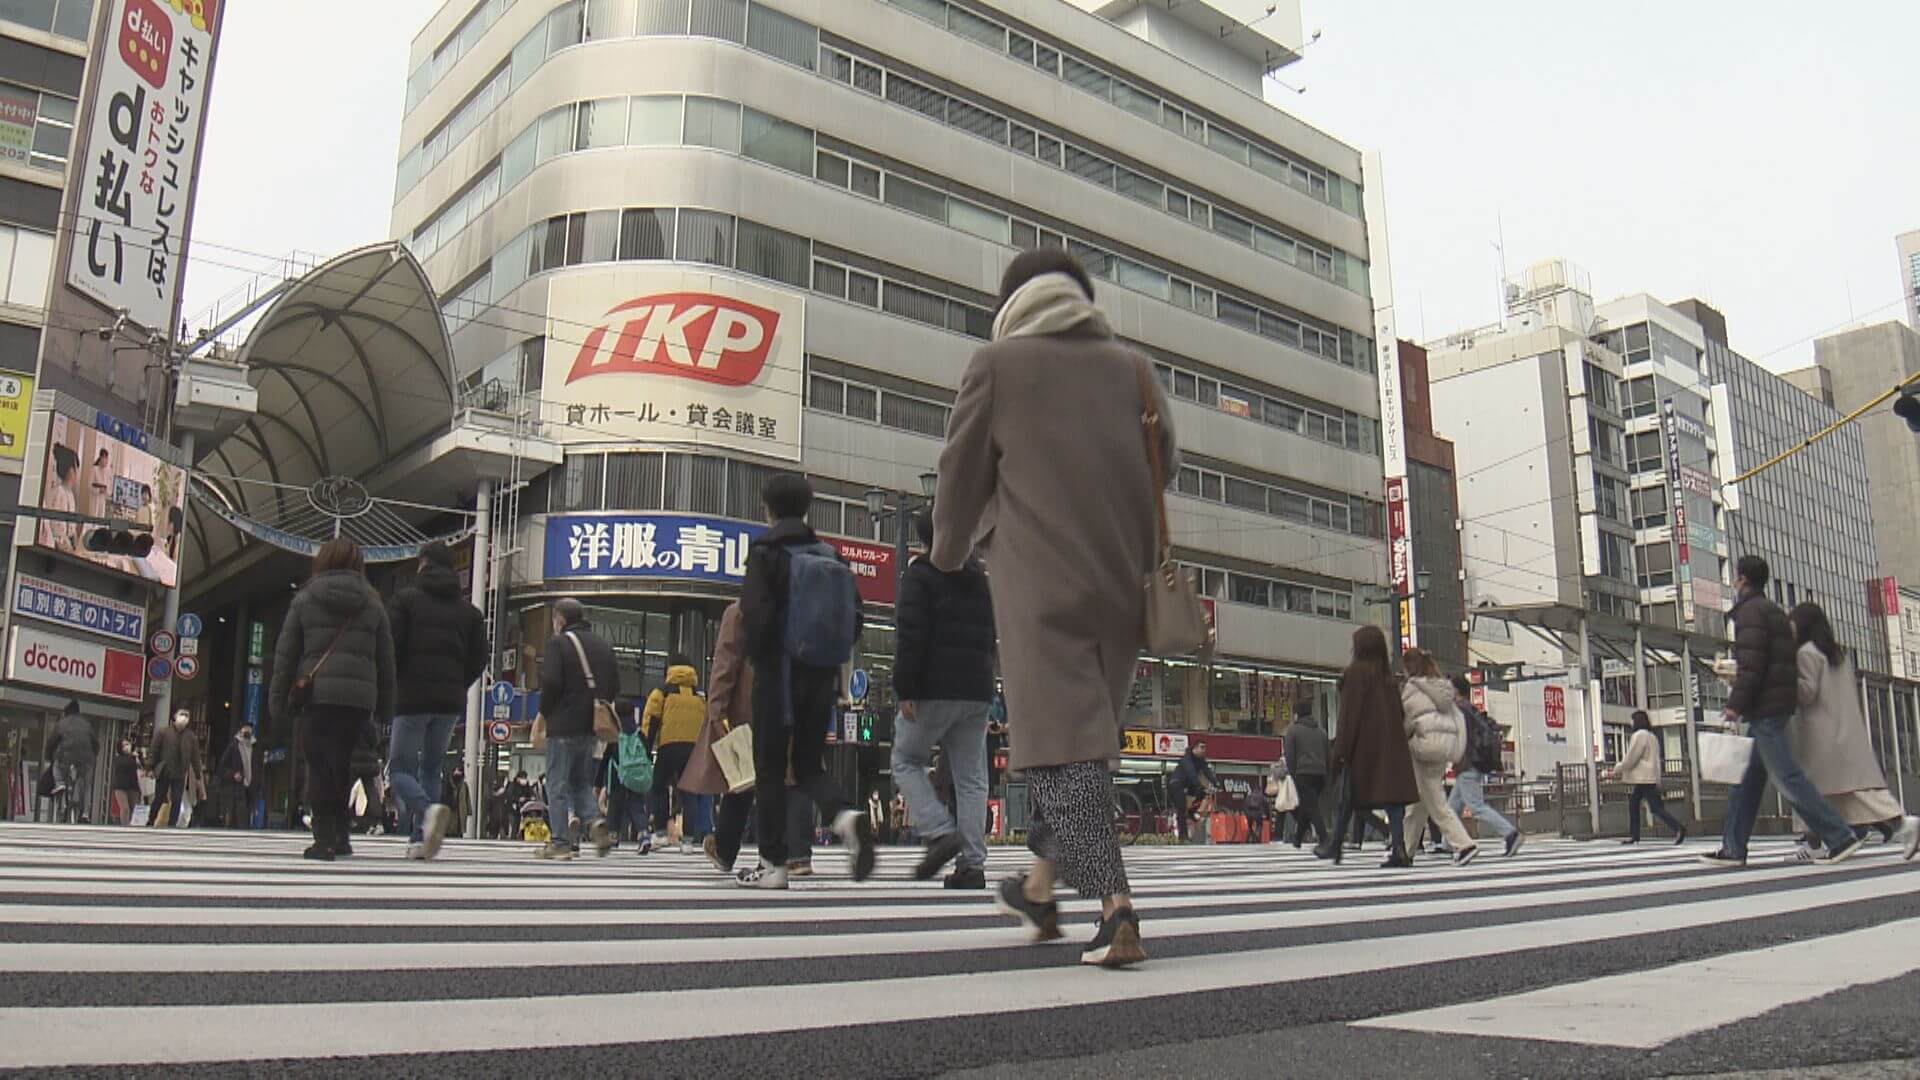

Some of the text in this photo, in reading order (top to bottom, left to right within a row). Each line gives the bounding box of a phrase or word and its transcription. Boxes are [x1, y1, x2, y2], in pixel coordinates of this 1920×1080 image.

[127, 7, 166, 57] d払い
[139, 100, 165, 195] おトクな
[87, 84, 146, 285] d払い
[592, 303, 764, 370] TKP
[566, 402, 777, 440] 貸ホール・貸会議室
[20, 588, 140, 636] 個別教室のトライ
[24, 642, 97, 679] docomo
